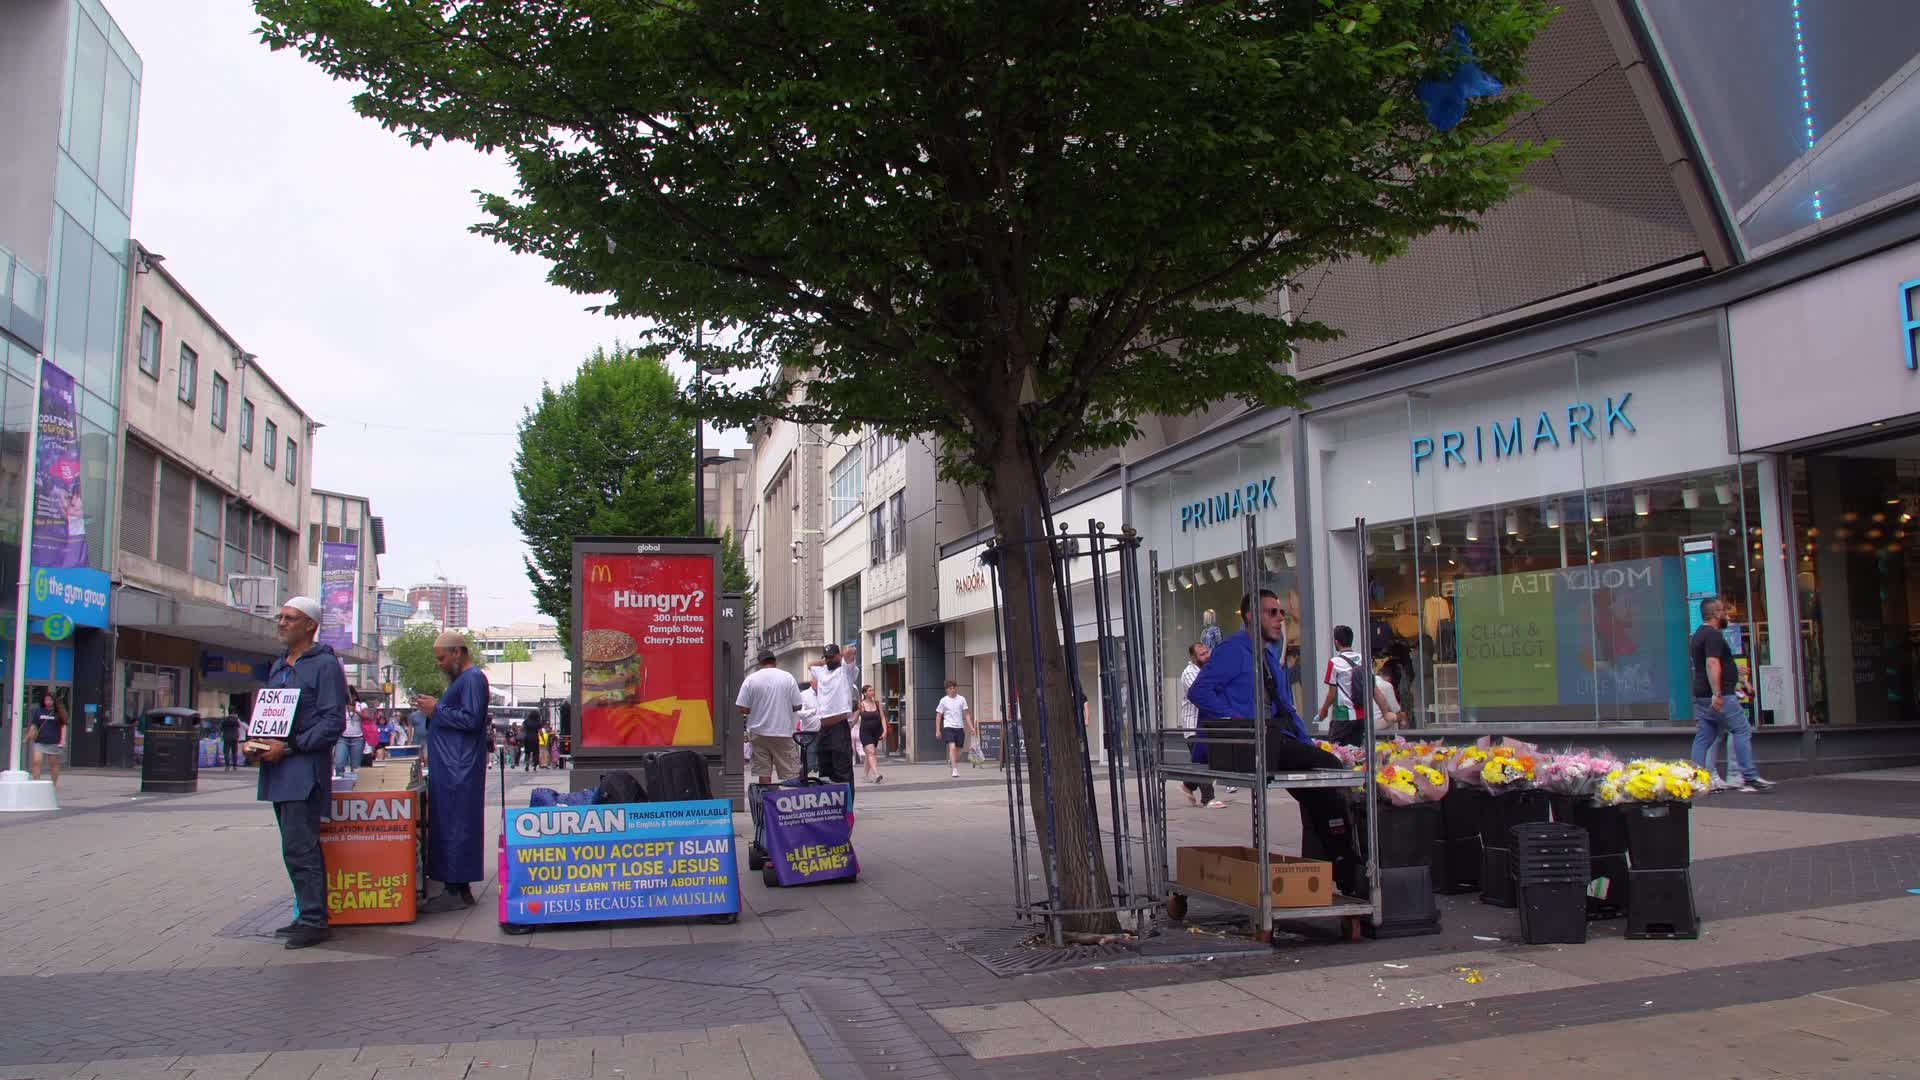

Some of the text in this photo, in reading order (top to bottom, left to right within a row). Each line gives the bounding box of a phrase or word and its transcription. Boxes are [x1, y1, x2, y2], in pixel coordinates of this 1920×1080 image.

[1411, 392, 1636, 474] PRIMARK
[1181, 476, 1277, 532] PRIMARK
[637, 544, 661, 553] global
[955, 571, 986, 593] PANDORA
[48, 575, 106, 611] the gym group
[614, 590, 704, 612] Hungry?
[653, 614, 704, 622] 300 metres
[648, 625, 704, 635] Temple Row,
[644, 636, 704, 646] Cherry Street
[258, 690, 297, 704] ASK me
[262, 706, 286, 717] about
[251, 720, 288, 735] ISLAM
[320, 798, 411, 823] URAN
[776, 791, 845, 812] QURAN
[516, 808, 625, 838] QURAN
[629, 808, 728, 820] TRANSLATION AVAILABLE
[636, 820, 660, 829] English
[778, 808, 842, 820] TRANSLATION AVAILABLE
[365, 824, 408, 832] AVAILABLE
[517, 838, 728, 864] WHEN YOU ACCEPT ISLAM
[794, 844, 827, 860] LIFE
[827, 843, 849, 854] JUST
[528, 857, 720, 881] YOU DON'T LOSE JESUS
[799, 855, 848, 876] GAME?
[327, 867, 408, 890] LIFE JUST
[521, 875, 728, 896] YOU JUST LEARN THE TRUTH ABOUT HIM
[327, 887, 402, 913] GAME?
[520, 891, 726, 916] I JESUS BECAUSE I'M MUSLIM
